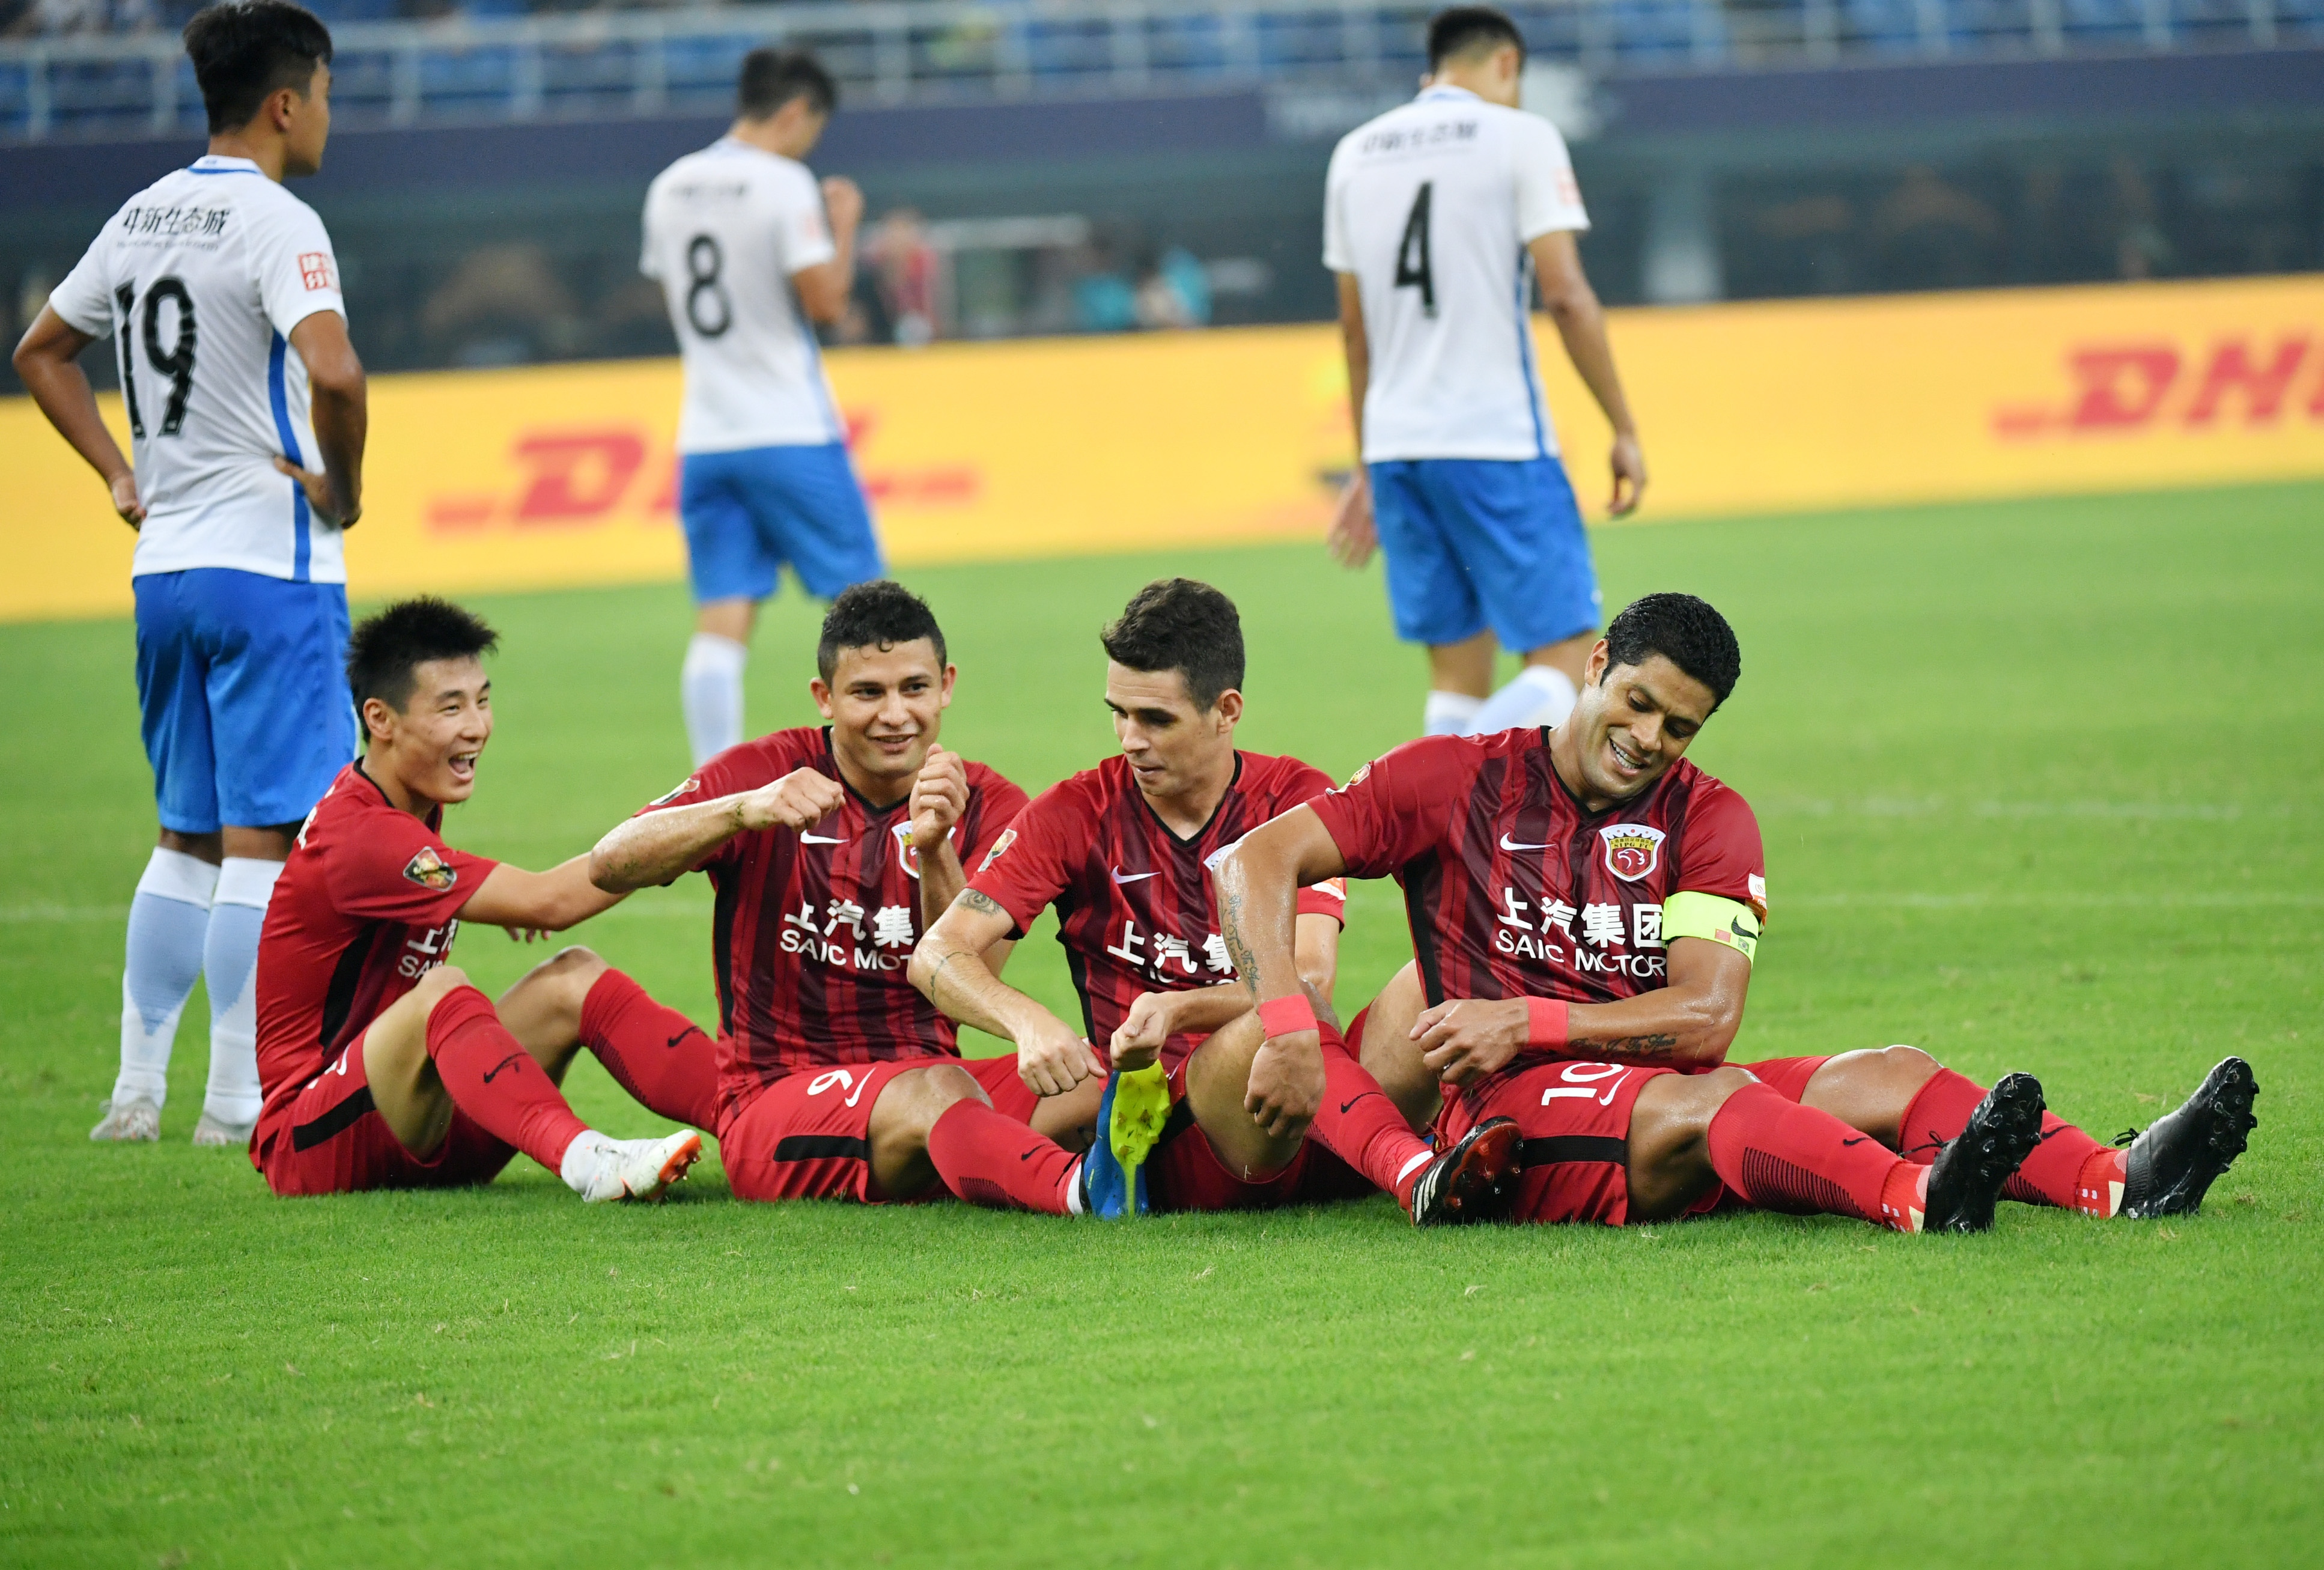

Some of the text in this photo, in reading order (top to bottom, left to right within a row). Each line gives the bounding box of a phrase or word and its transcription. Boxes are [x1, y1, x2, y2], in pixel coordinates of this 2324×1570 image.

[1395, 180, 1438, 318] 4
[687, 234, 732, 336] 8
[115, 275, 198, 439] 19
[2064, 339, 2324, 428] DH
[779, 929, 847, 966] SAIC
[1495, 928, 1565, 963] SAIC
[1497, 887, 1664, 949] 上汽集团
[807, 1069, 853, 1096] 9
[1541, 1062, 1625, 1106] 10
